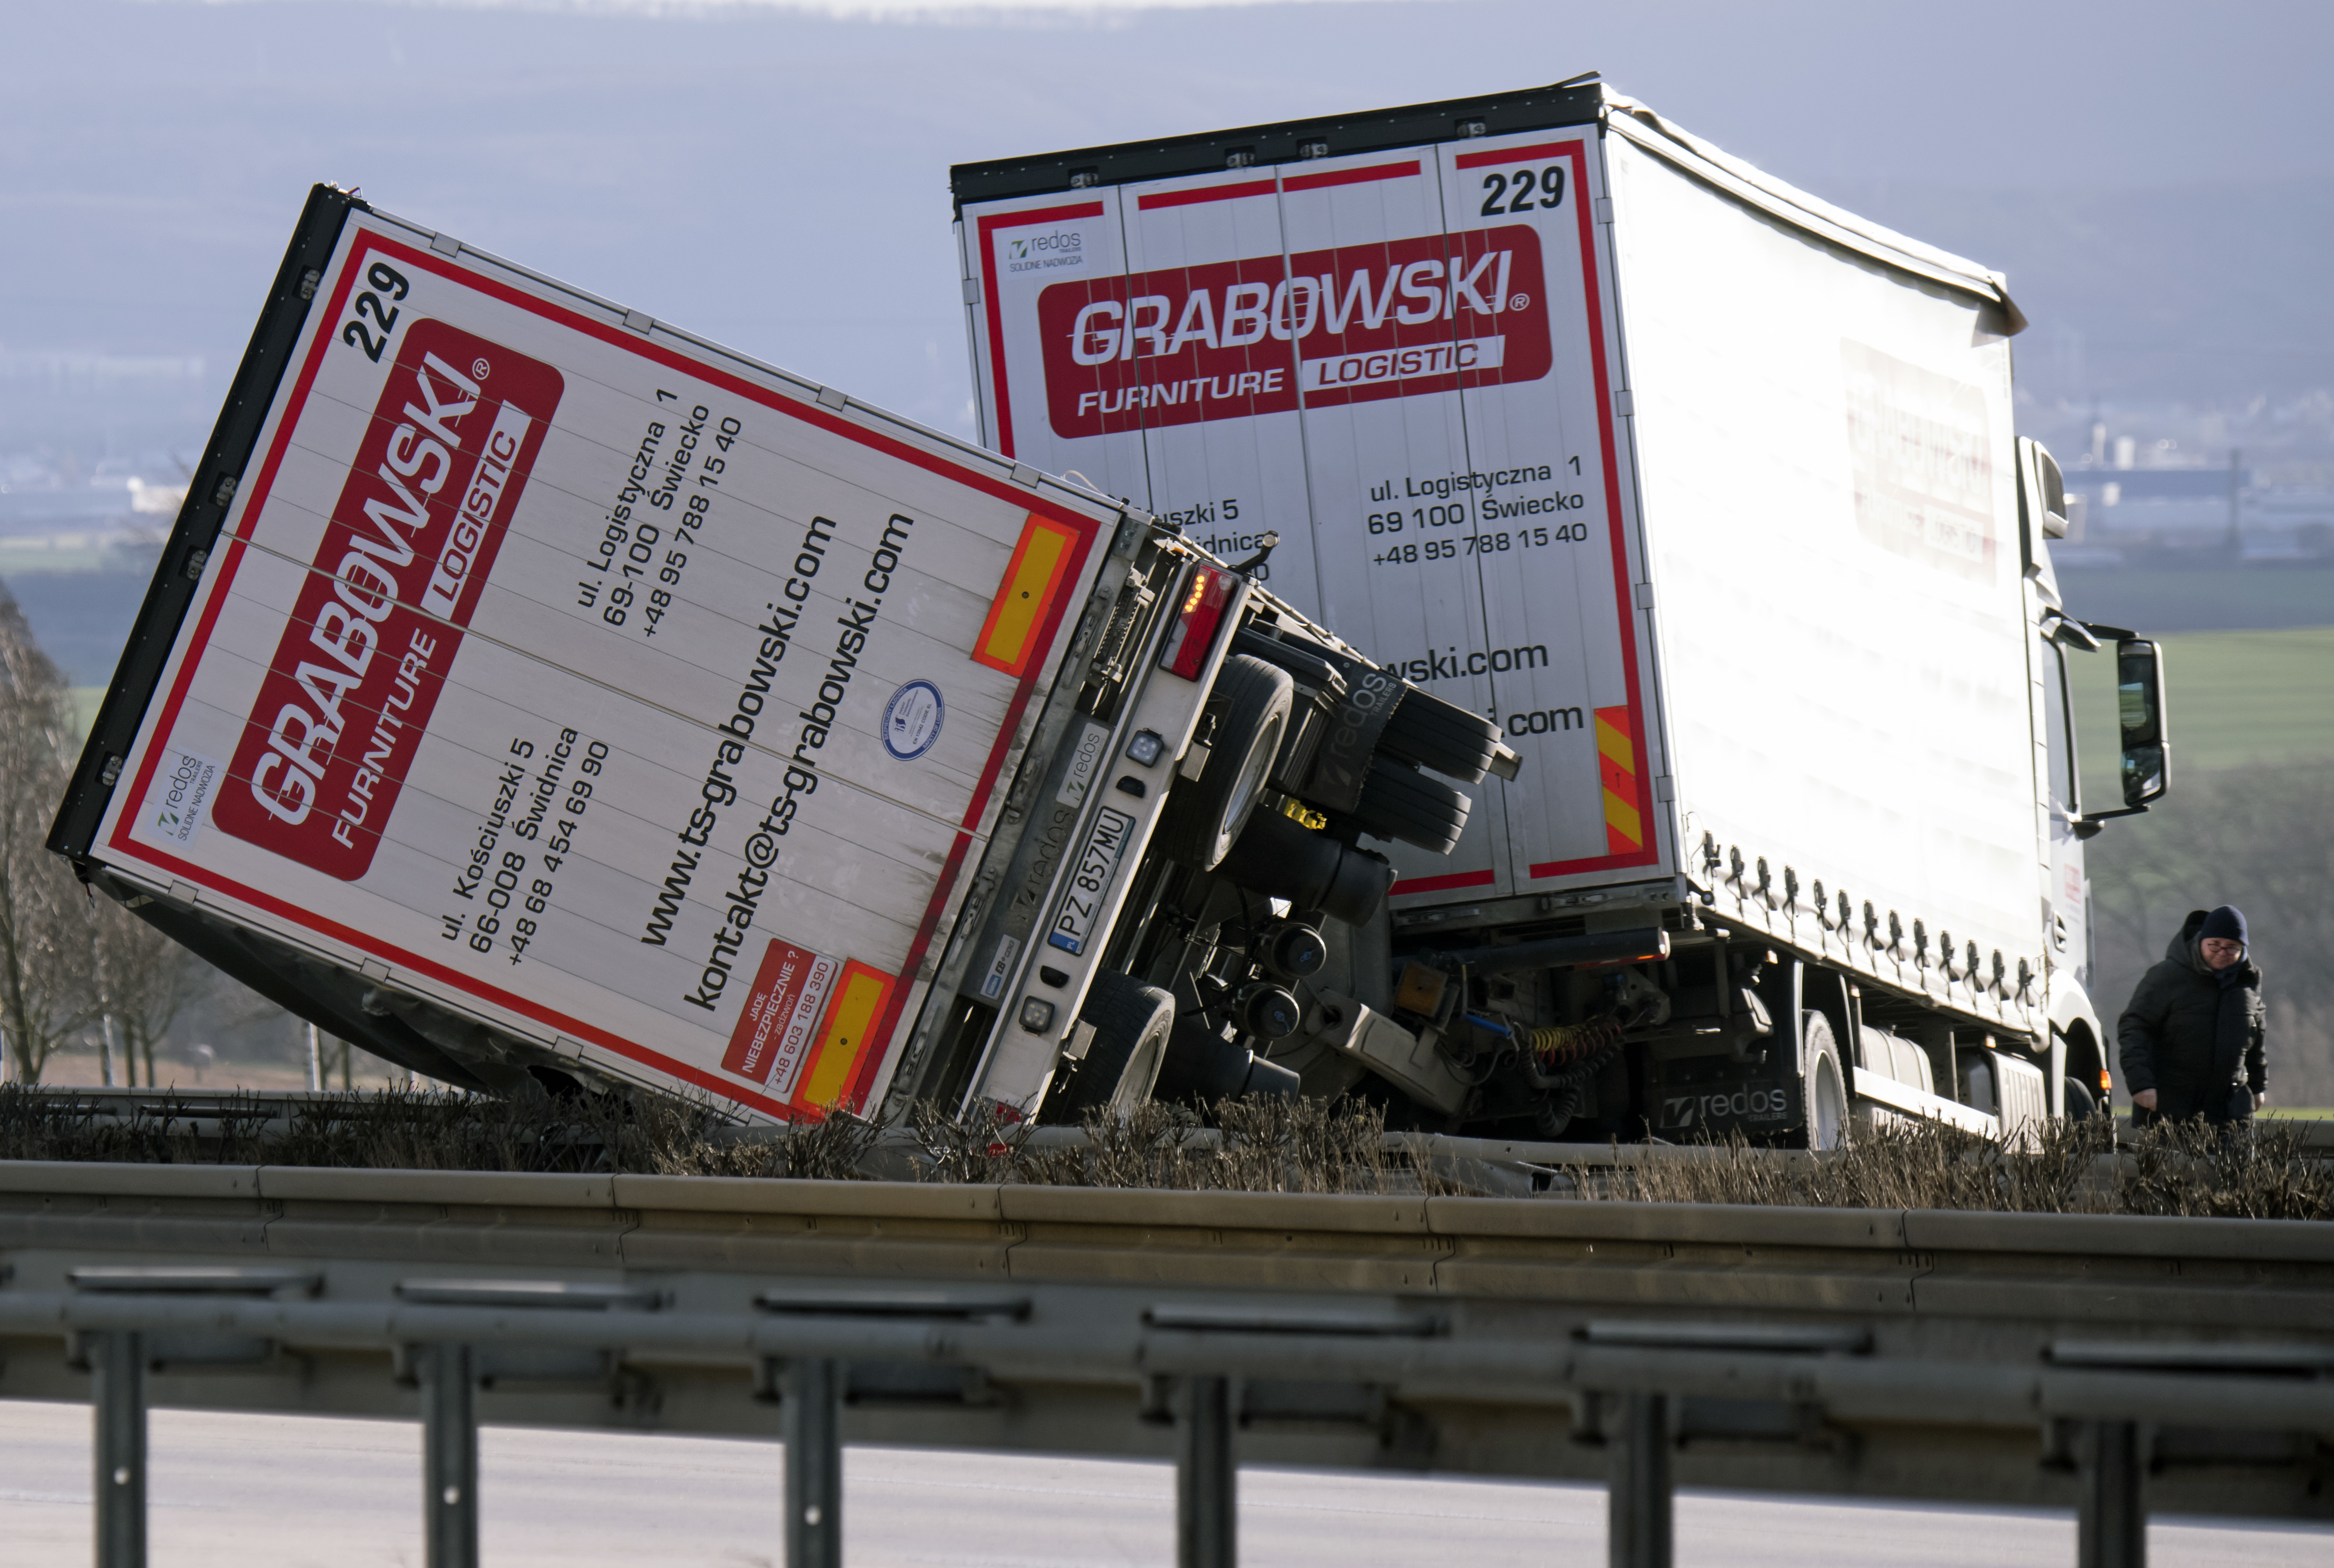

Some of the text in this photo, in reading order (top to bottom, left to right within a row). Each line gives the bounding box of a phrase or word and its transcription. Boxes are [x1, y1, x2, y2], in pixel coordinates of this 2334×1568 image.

[1481, 166, 1565, 217] 229
[1010, 256, 1083, 272] SOLIDNE NADWOZIA
[1031, 230, 1081, 251] redos
[343, 262, 410, 364] 229
[1078, 343, 1479, 417] FURNITURE LOGISTIC
[578, 389, 678, 608] ul. Logistyczna 1
[1371, 456, 1582, 501] ul. Logistyczna 1
[603, 405, 709, 626] 69-100 Świecko
[644, 417, 742, 637] +48 95 788 15 40
[1223, 498, 1239, 520] 5
[1368, 493, 1585, 535] 69 100 Świecko
[1373, 523, 1588, 566] +48 95 788 15 40
[332, 431, 516, 850] FURNITURE LOGISTIC
[1370, 682, 1397, 716] TRAILERS
[641, 515, 837, 947] www.ts-grabowski.com
[922, 732, 936, 749] SAFETY
[1073, 733, 1100, 778] redos
[165, 756, 196, 809] redos
[190, 760, 203, 785] TRAILERS
[683, 513, 915, 1012] kontakt@ts-grabowski.com
[178, 765, 216, 841] SOLIDNE NADWOZIA
[441, 738, 534, 941] ul. Kościuszki 5
[469, 728, 579, 953] 66-008 Świdnica
[510, 741, 609, 965] +48 68 454 69 90
[1058, 814, 1124, 937] PZ 857MU
[1066, 940, 1075, 950] PL
[742, 961, 796, 1073] NIEBEZPIECZNIE
[749, 992, 768, 1022] JADĘ
[774, 994, 796, 1035] zadzwoń
[775, 962, 829, 1084] +48 603 188 390
[1700, 1082, 1787, 1117] redos
